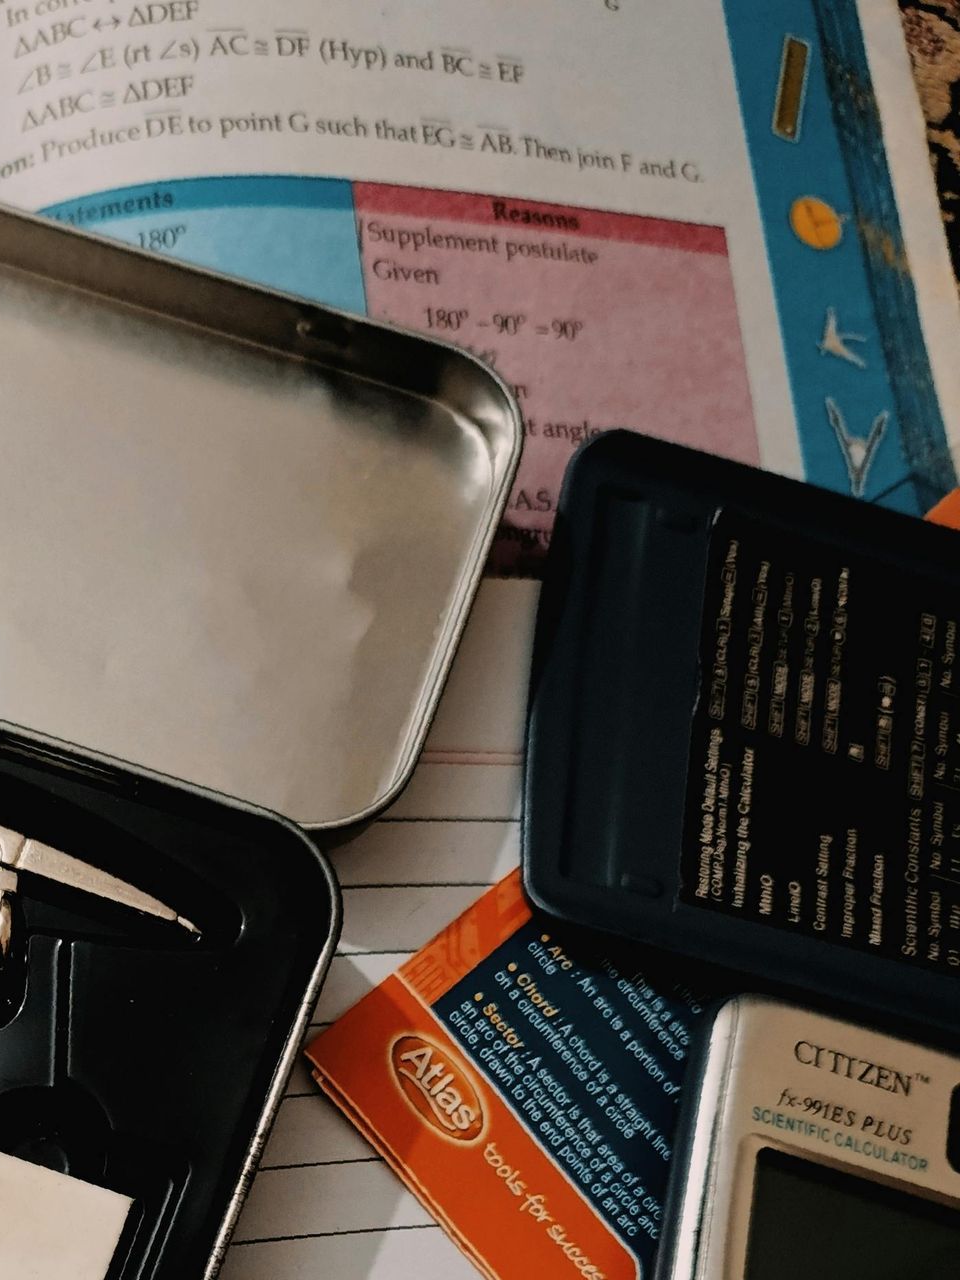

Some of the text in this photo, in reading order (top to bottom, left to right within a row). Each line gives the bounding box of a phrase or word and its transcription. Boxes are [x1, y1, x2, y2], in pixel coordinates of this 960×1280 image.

[319, 38, 434, 72] (Hyp) and
[41, 112, 676, 180] Produce to point such that Then join and
[366, 219, 600, 265] Supplement postulate
[372, 257, 440, 286] Given
[904, 808, 921, 883] Constants
[527, 940, 557, 976] circle
[547, 945, 664, 1082] Arc arc portion
[617, 979, 685, 1060] circumference
[400, 1046, 477, 1132] Atlas
[482, 1002, 624, 1173] Sector sector that area
[516, 972, 657, 1139] Chord chord straight
[517, 998, 636, 1139] circumference circle
[448, 1010, 637, 1236] circle, drawn end points arc
[474, 1018, 640, 1215] arc the circumference circle
[751, 1105, 930, 1174] SCIENTIFIC CALCULATOR
[861, 1114, 913, 1146] PLUS
[483, 1142, 527, 1197] tools
[519, 1194, 553, 1224] for
